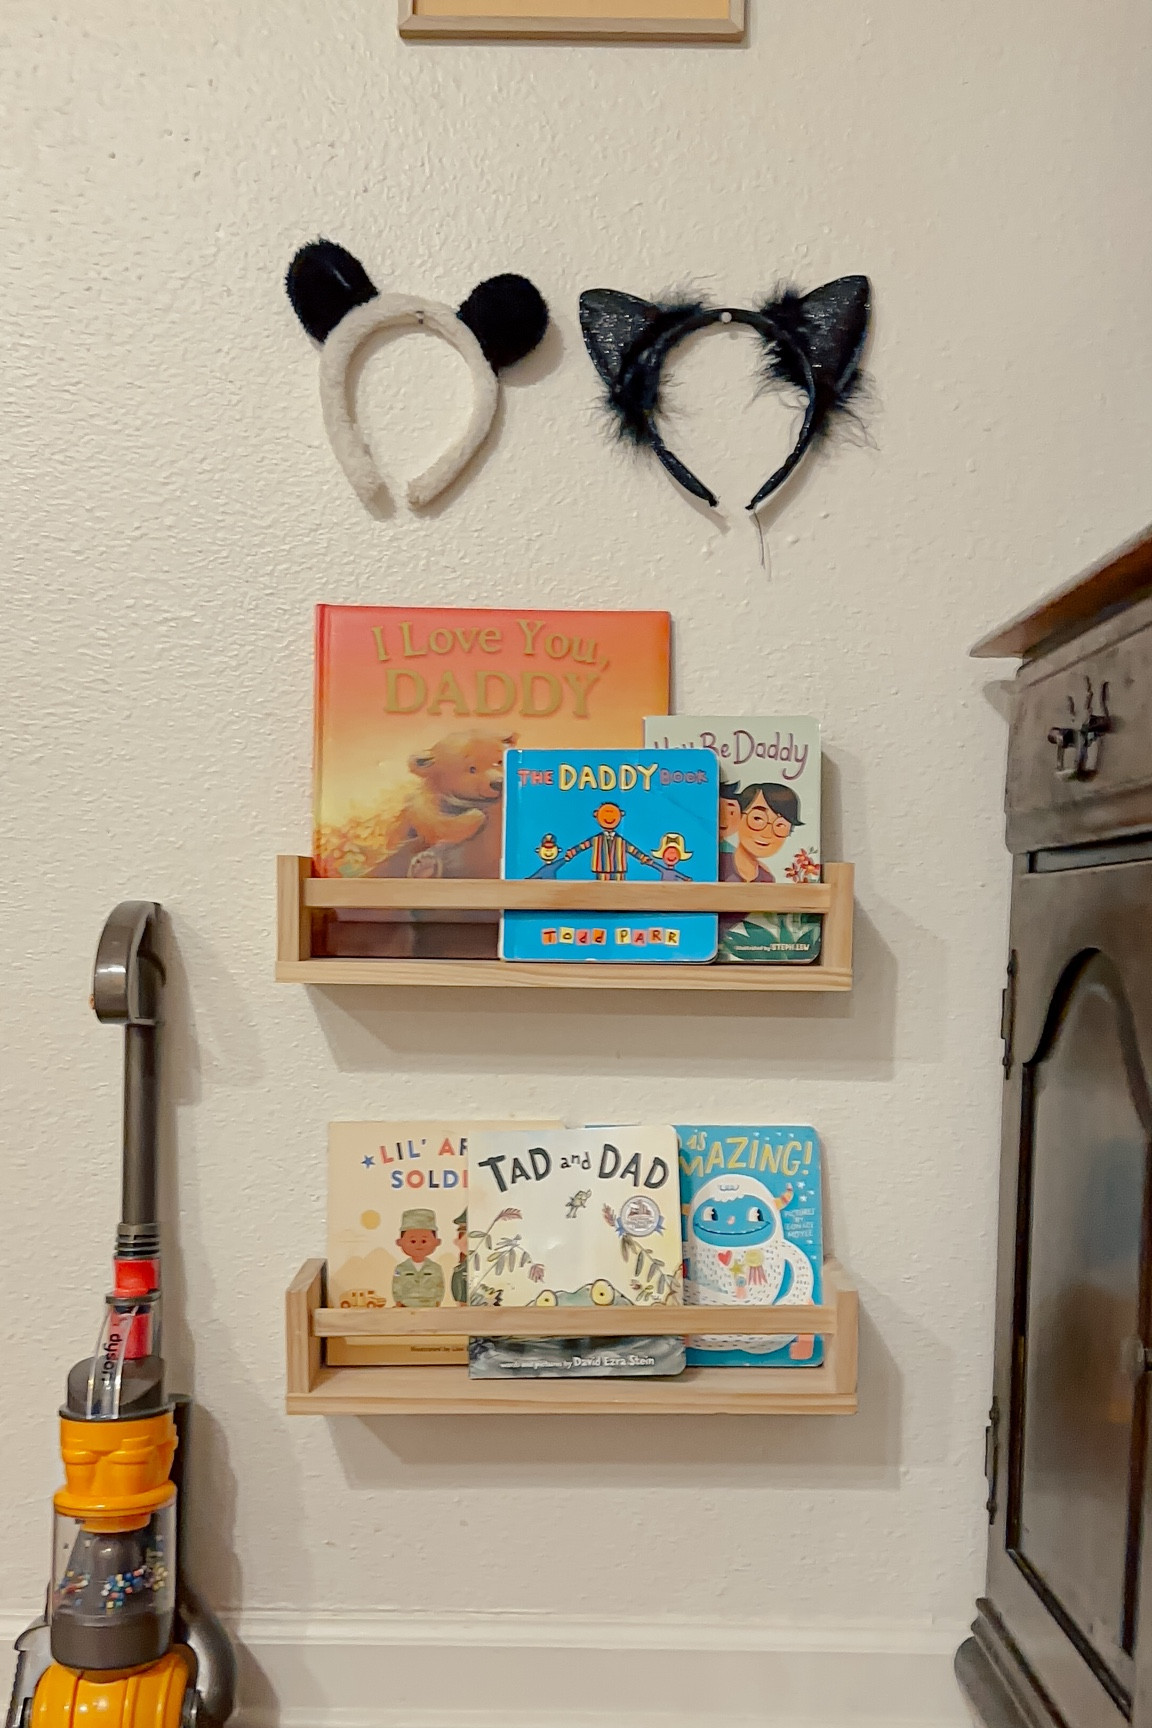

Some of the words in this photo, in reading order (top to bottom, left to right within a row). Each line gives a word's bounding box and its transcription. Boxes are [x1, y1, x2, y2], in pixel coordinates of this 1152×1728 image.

[371, 625, 391, 661] I
[399, 621, 502, 658] Love
[517, 618, 610, 671] You,
[384, 668, 600, 719] DADDY
[517, 769, 554, 786] THE
[559, 763, 658, 791] DADDY
[733, 730, 808, 780] Daddy
[618, 928, 678, 944] PARR
[379, 1139, 426, 1164] LIL'
[478, 1147, 552, 1192] TAD
[560, 1151, 592, 1170] and
[598, 1143, 669, 1189] DAD
[101, 1333, 122, 1382] dyson
[572, 1356, 601, 1367] David
[604, 1357, 626, 1366] Ezra
[628, 1355, 655, 1366] Stein
